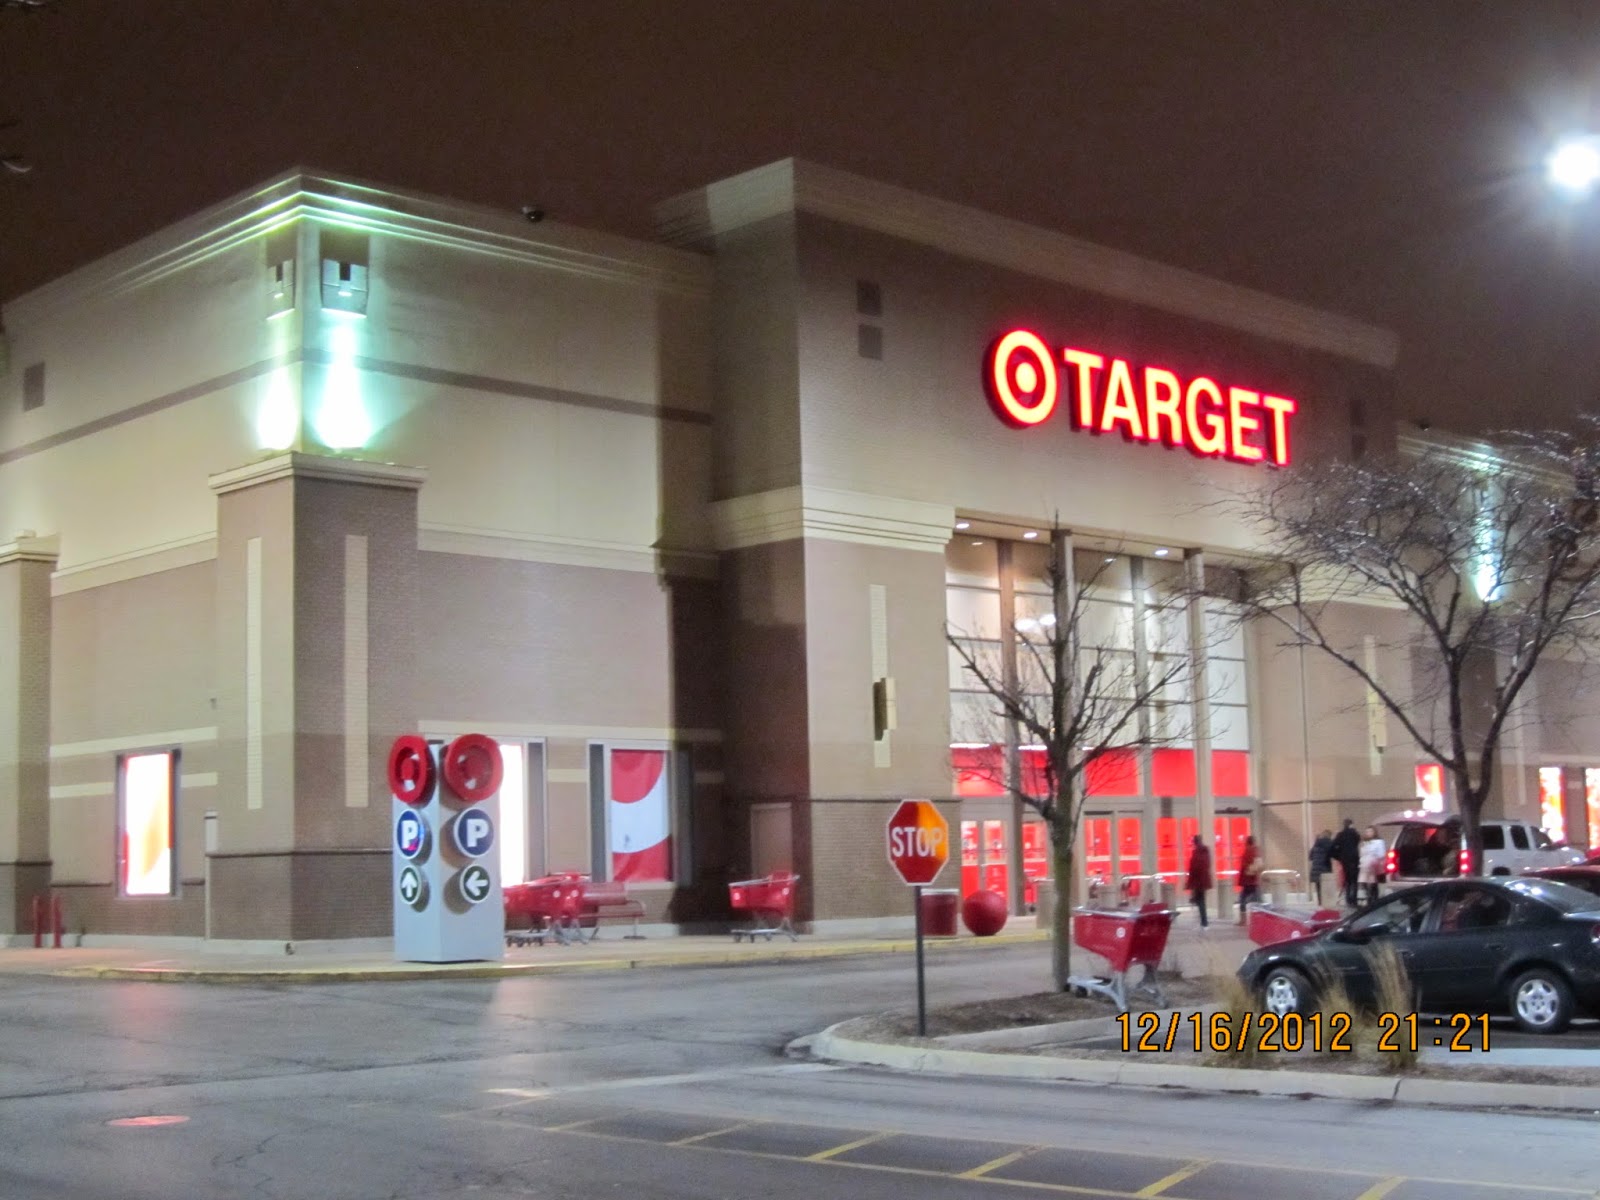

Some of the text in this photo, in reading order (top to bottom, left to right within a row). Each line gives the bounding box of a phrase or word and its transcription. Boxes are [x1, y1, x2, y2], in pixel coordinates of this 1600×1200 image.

[1062, 347, 1296, 466] TARGET
[401, 819, 419, 849] P
[466, 818, 489, 848] P
[891, 826, 943, 857] STOP
